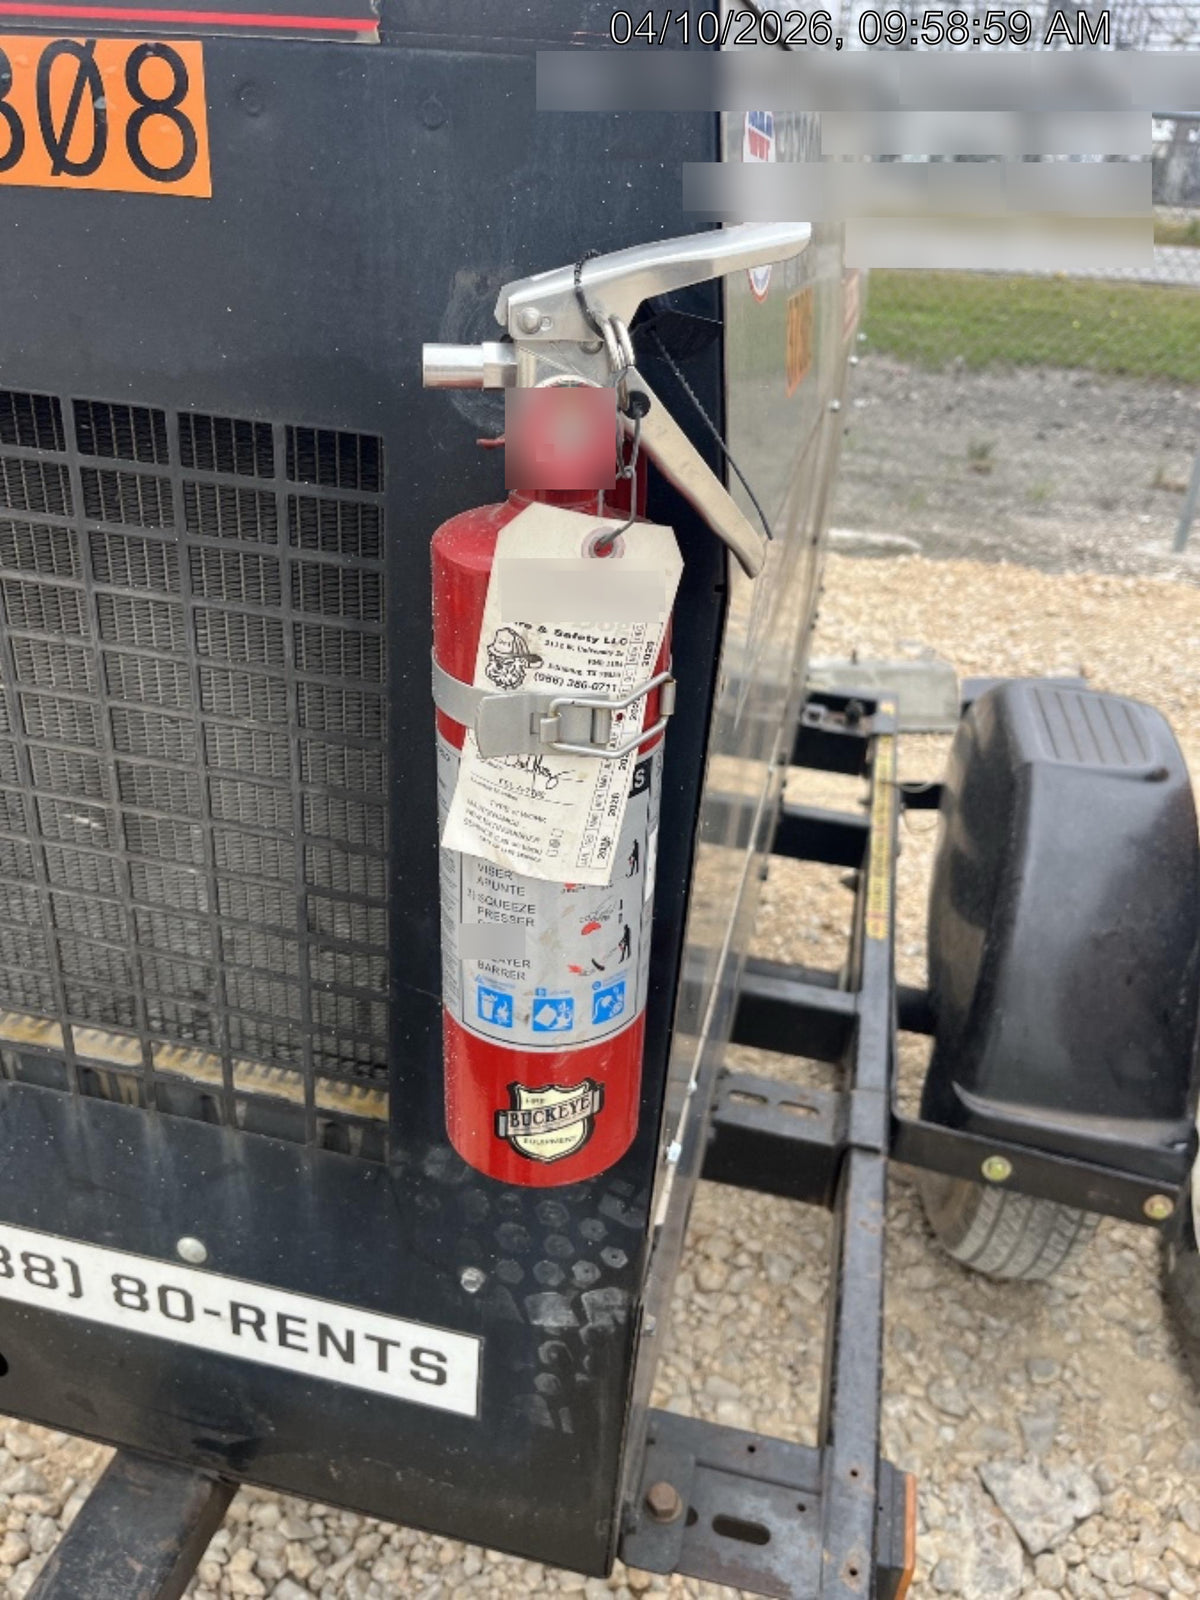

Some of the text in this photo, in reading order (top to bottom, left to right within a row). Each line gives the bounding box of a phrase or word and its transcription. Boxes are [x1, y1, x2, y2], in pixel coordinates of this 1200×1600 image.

[553, 628, 600, 645] Safety
[603, 636, 628, 646] LLC
[477, 876, 526, 897] APUNTE
[477, 893, 537, 914] SQUEEZE
[509, 1094, 591, 1128] BUCKEYE
[111, 1273, 447, 1386] 80-RENTS
